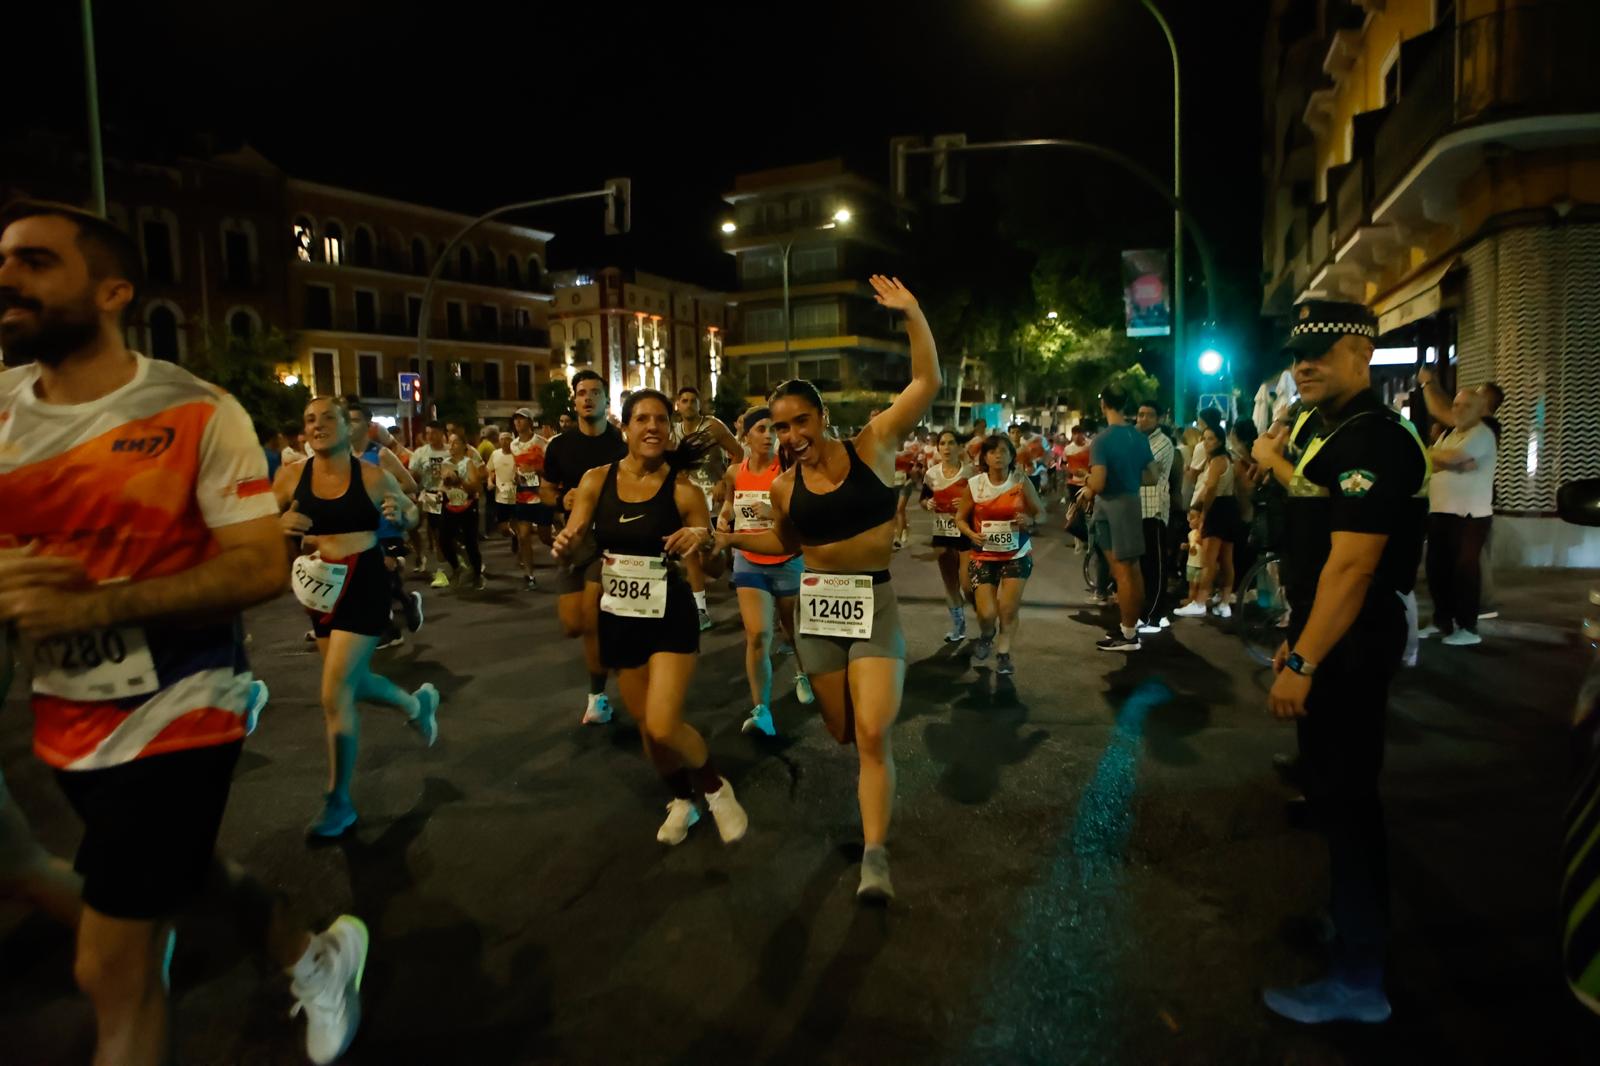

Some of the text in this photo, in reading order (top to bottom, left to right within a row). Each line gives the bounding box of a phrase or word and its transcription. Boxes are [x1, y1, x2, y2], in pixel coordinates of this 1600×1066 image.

[741, 507, 755, 518] 63
[988, 533, 1013, 544] 4658
[296, 563, 334, 597] 22777
[609, 579, 651, 600] 2984
[808, 598, 864, 620] 12405
